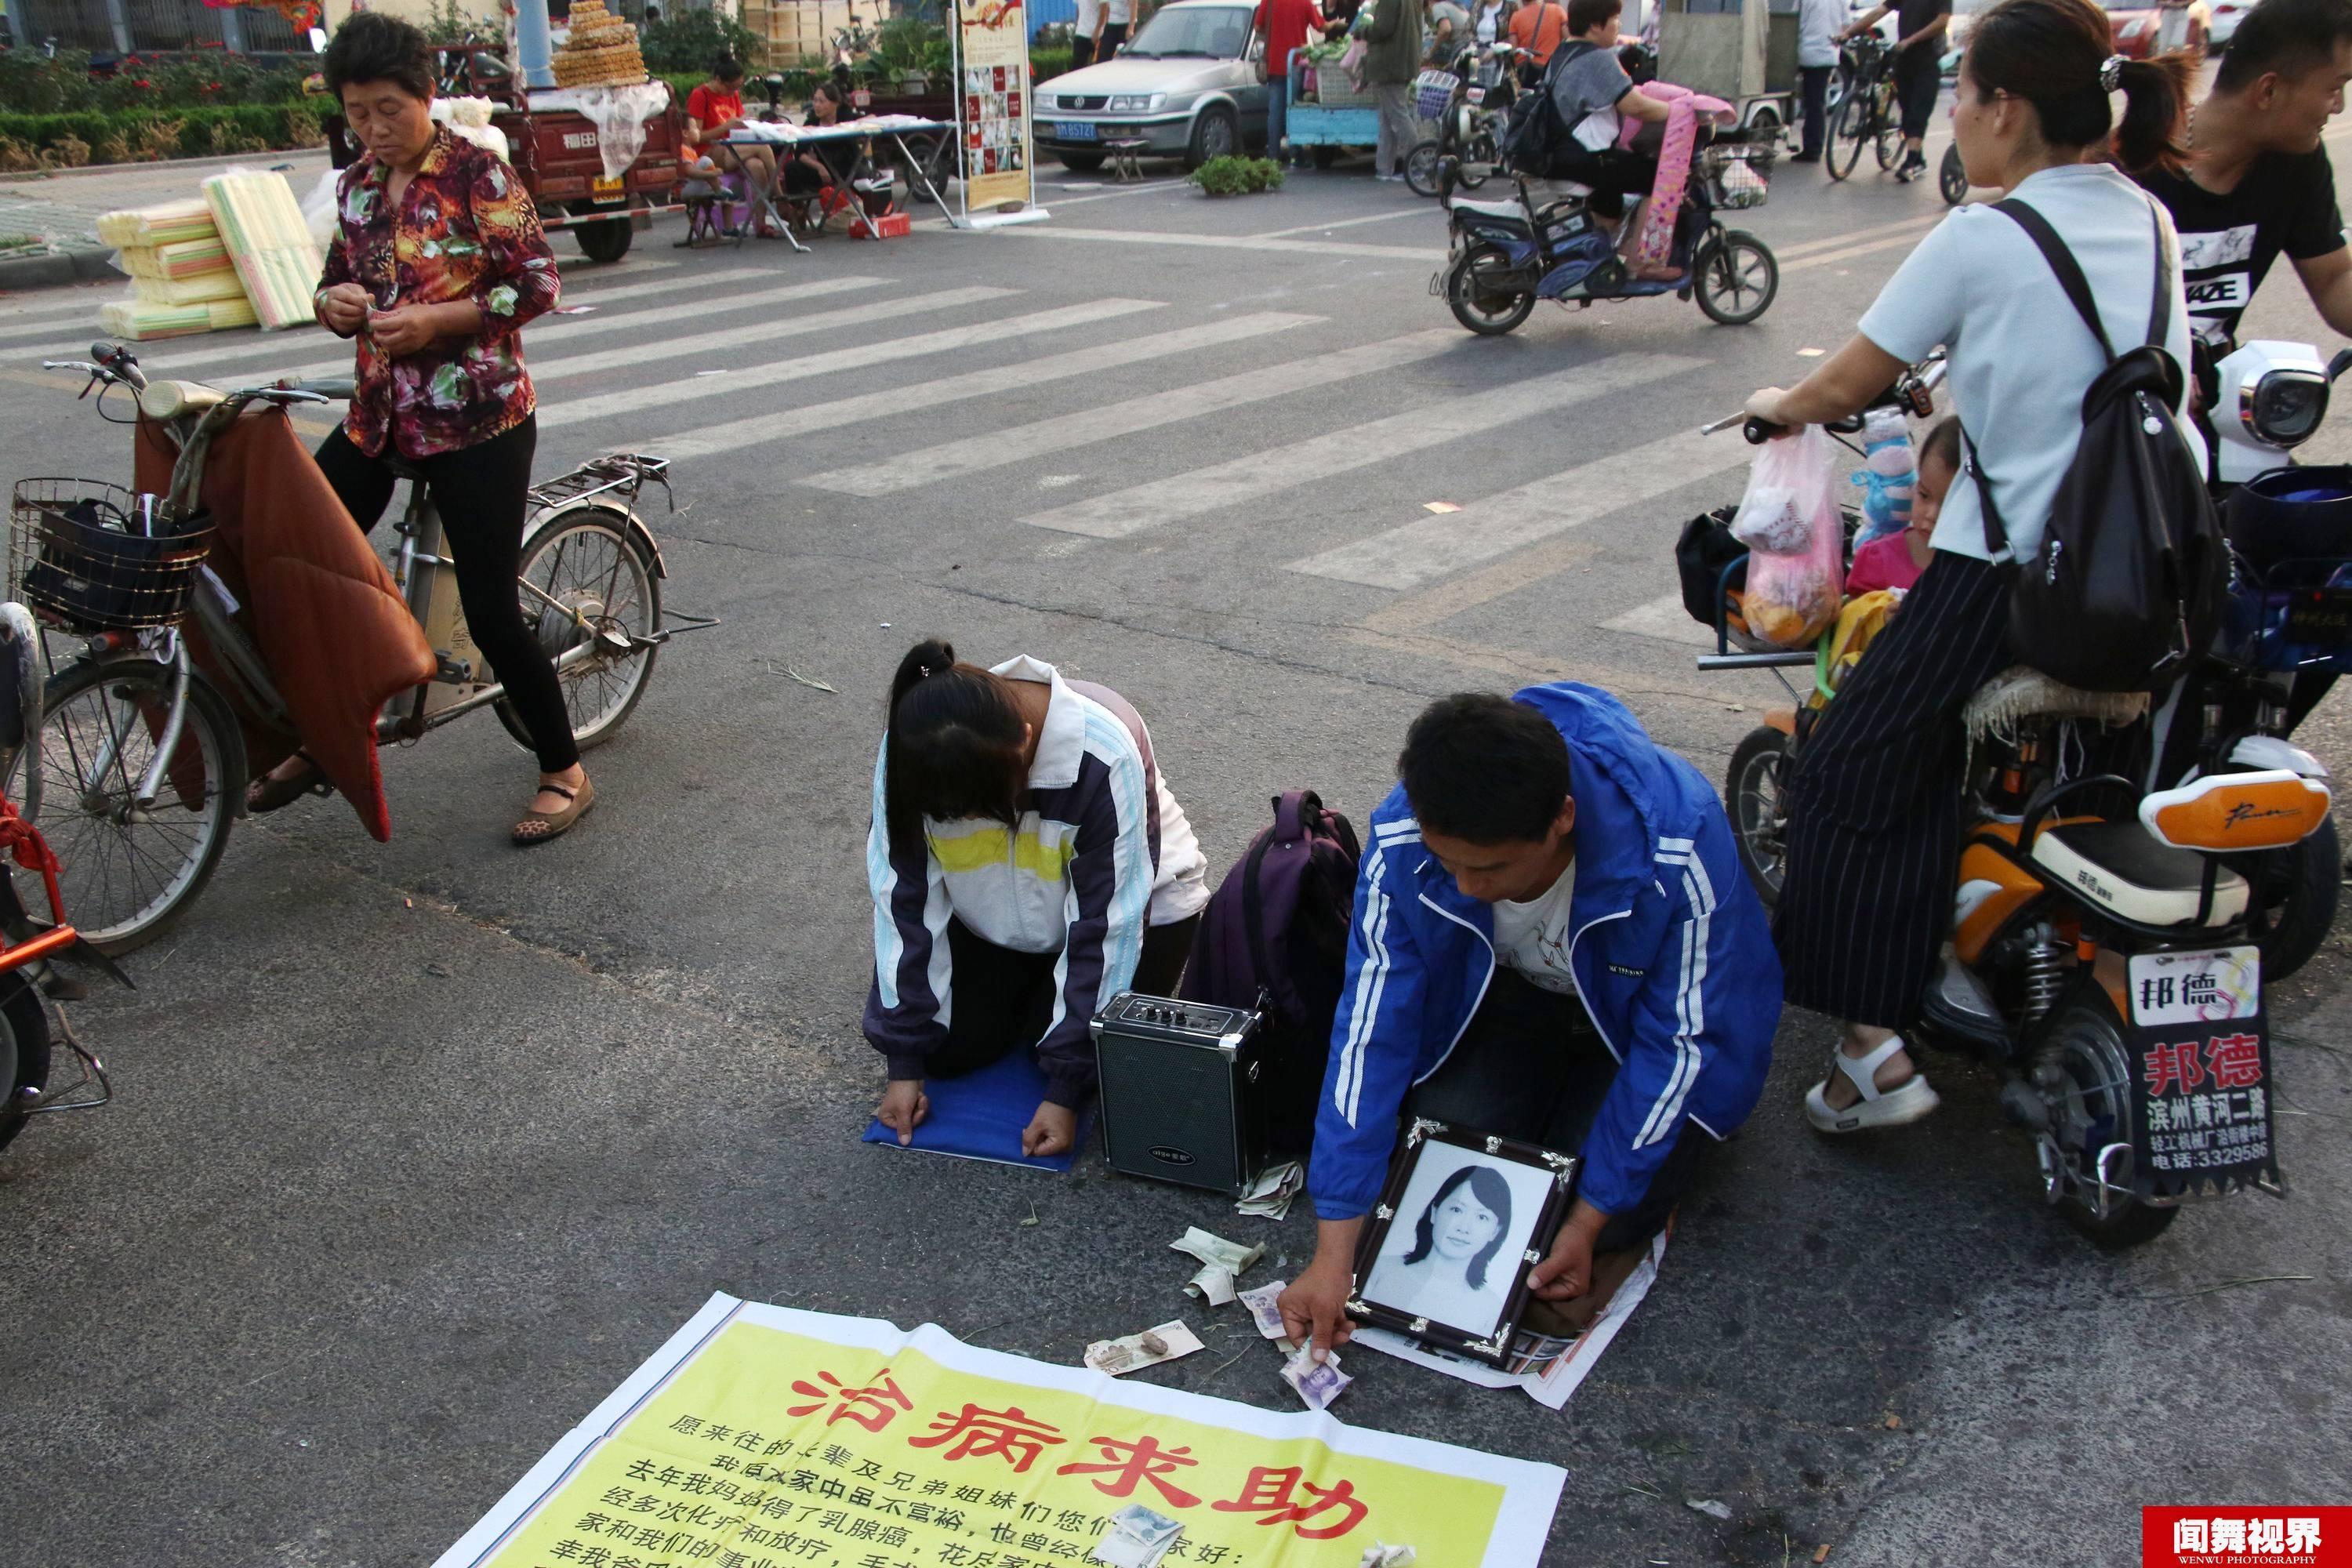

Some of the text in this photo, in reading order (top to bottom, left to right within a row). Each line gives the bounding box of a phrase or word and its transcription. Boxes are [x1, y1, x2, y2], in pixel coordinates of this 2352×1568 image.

[563, 132, 597, 149] 福田
[2186, 280, 2238, 304] AZE
[2139, 972, 2216, 1010] 邦德
[2143, 1033, 2263, 1097] 邦德
[2147, 1087, 2266, 1131] 滨州黄河二路
[786, 1367, 1369, 1540] 治病求助
